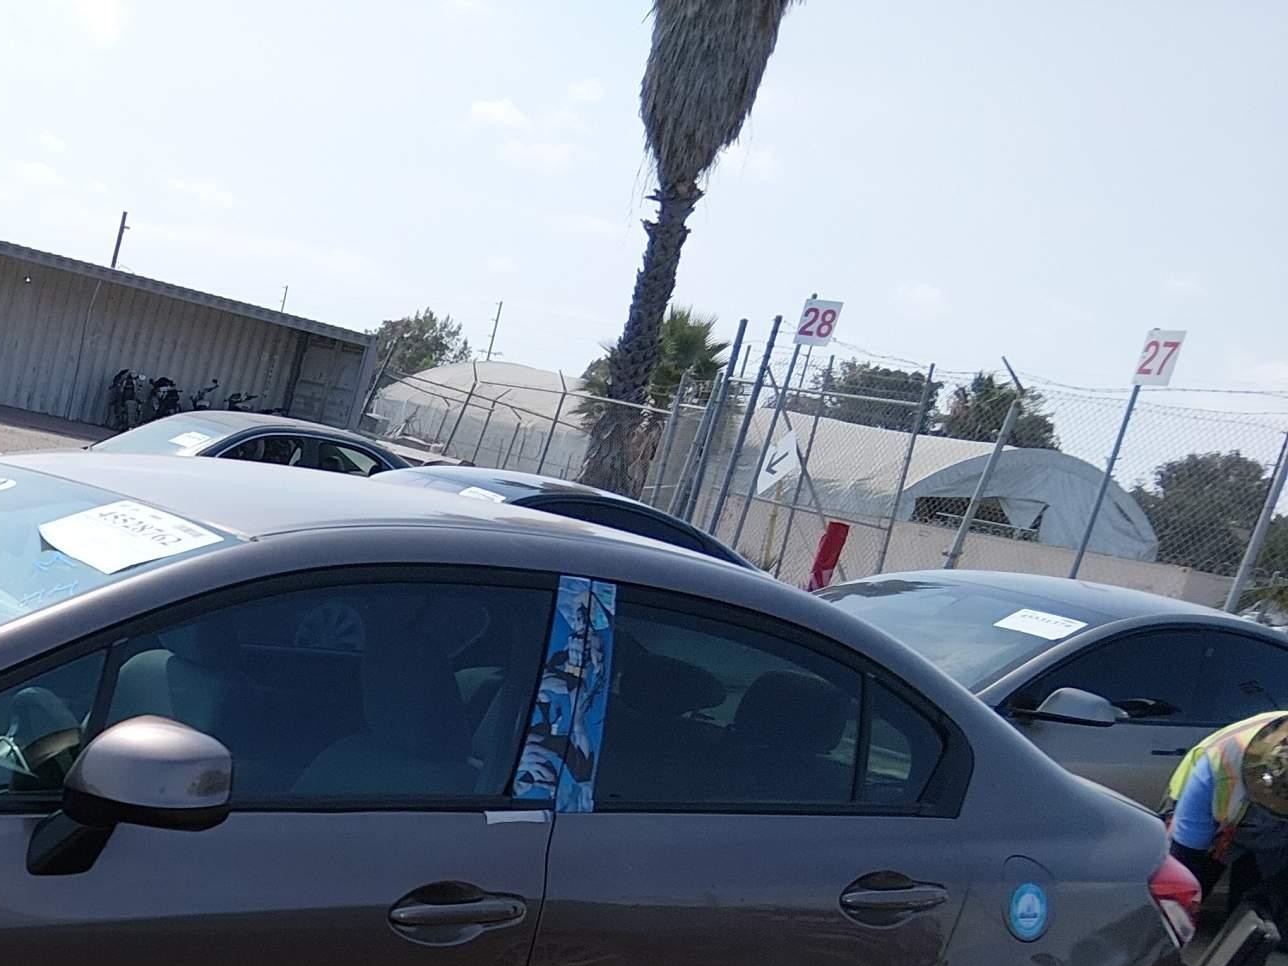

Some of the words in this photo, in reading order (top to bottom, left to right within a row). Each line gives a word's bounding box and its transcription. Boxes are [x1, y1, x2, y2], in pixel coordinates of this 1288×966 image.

[798, 307, 836, 338] 28
[1136, 340, 1181, 375] 27
[98, 511, 183, 546] 45528762
